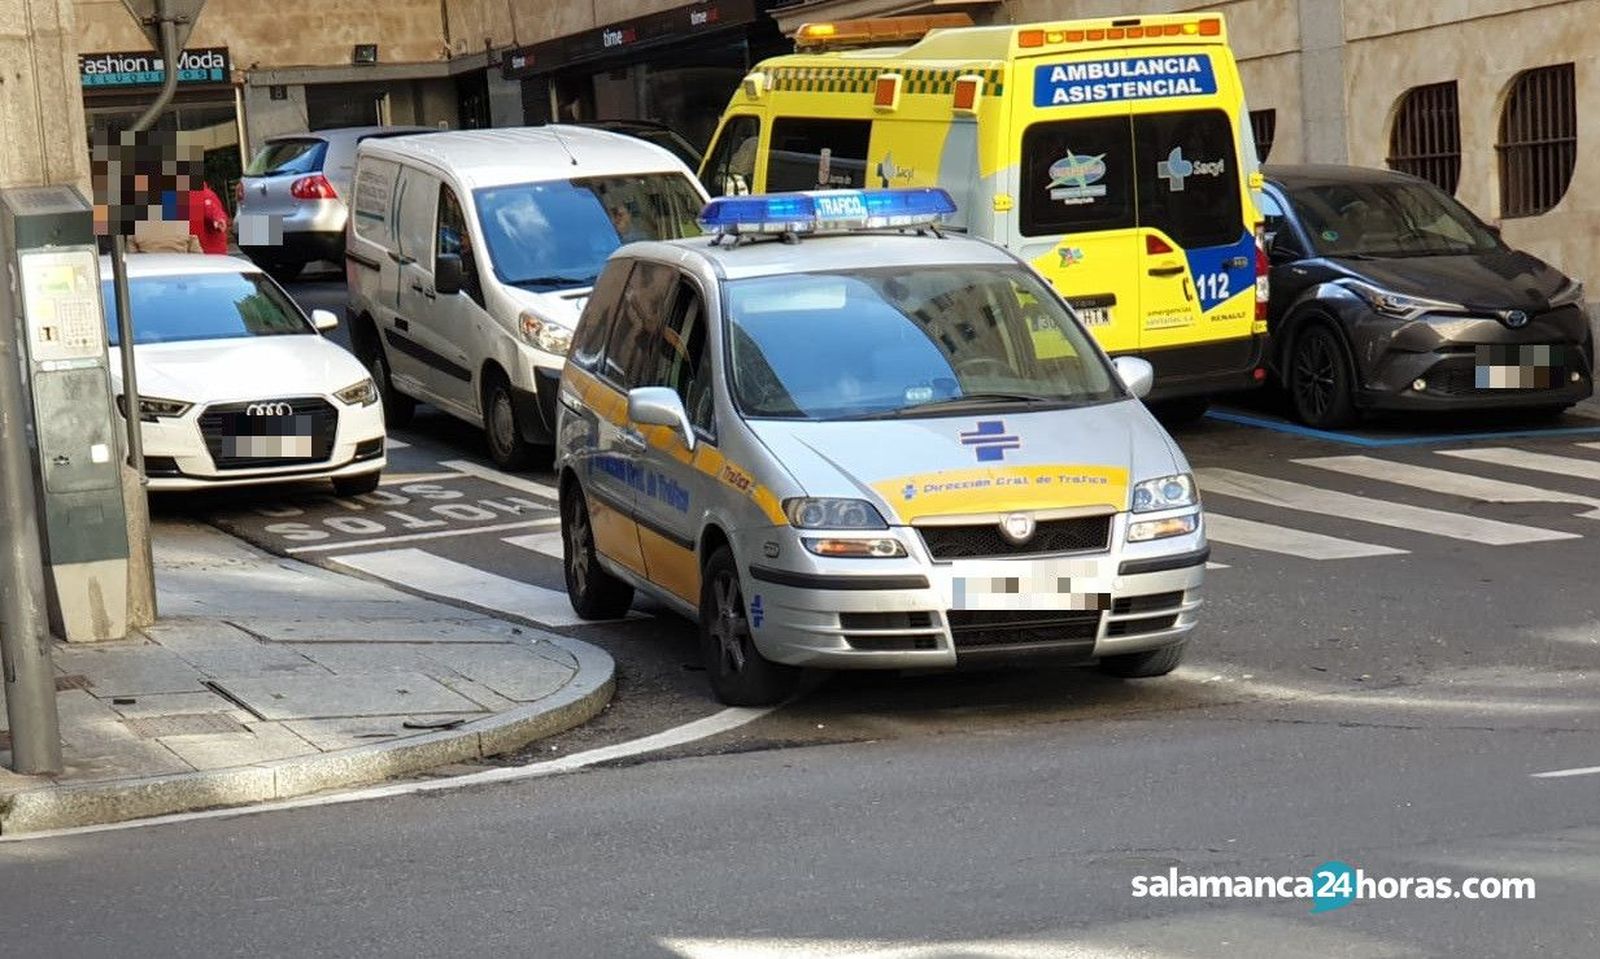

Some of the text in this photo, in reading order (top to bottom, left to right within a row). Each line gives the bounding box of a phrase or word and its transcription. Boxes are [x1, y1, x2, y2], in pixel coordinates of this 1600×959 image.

[82, 71, 206, 83] ELUQUEOS
[1050, 56, 1202, 83] AMBULANCIA
[1052, 77, 1204, 104] ASISTENCIAL
[1193, 159, 1225, 177] Sacyl
[1197, 272, 1231, 300] 112
[1211, 311, 1246, 322] RENAULT
